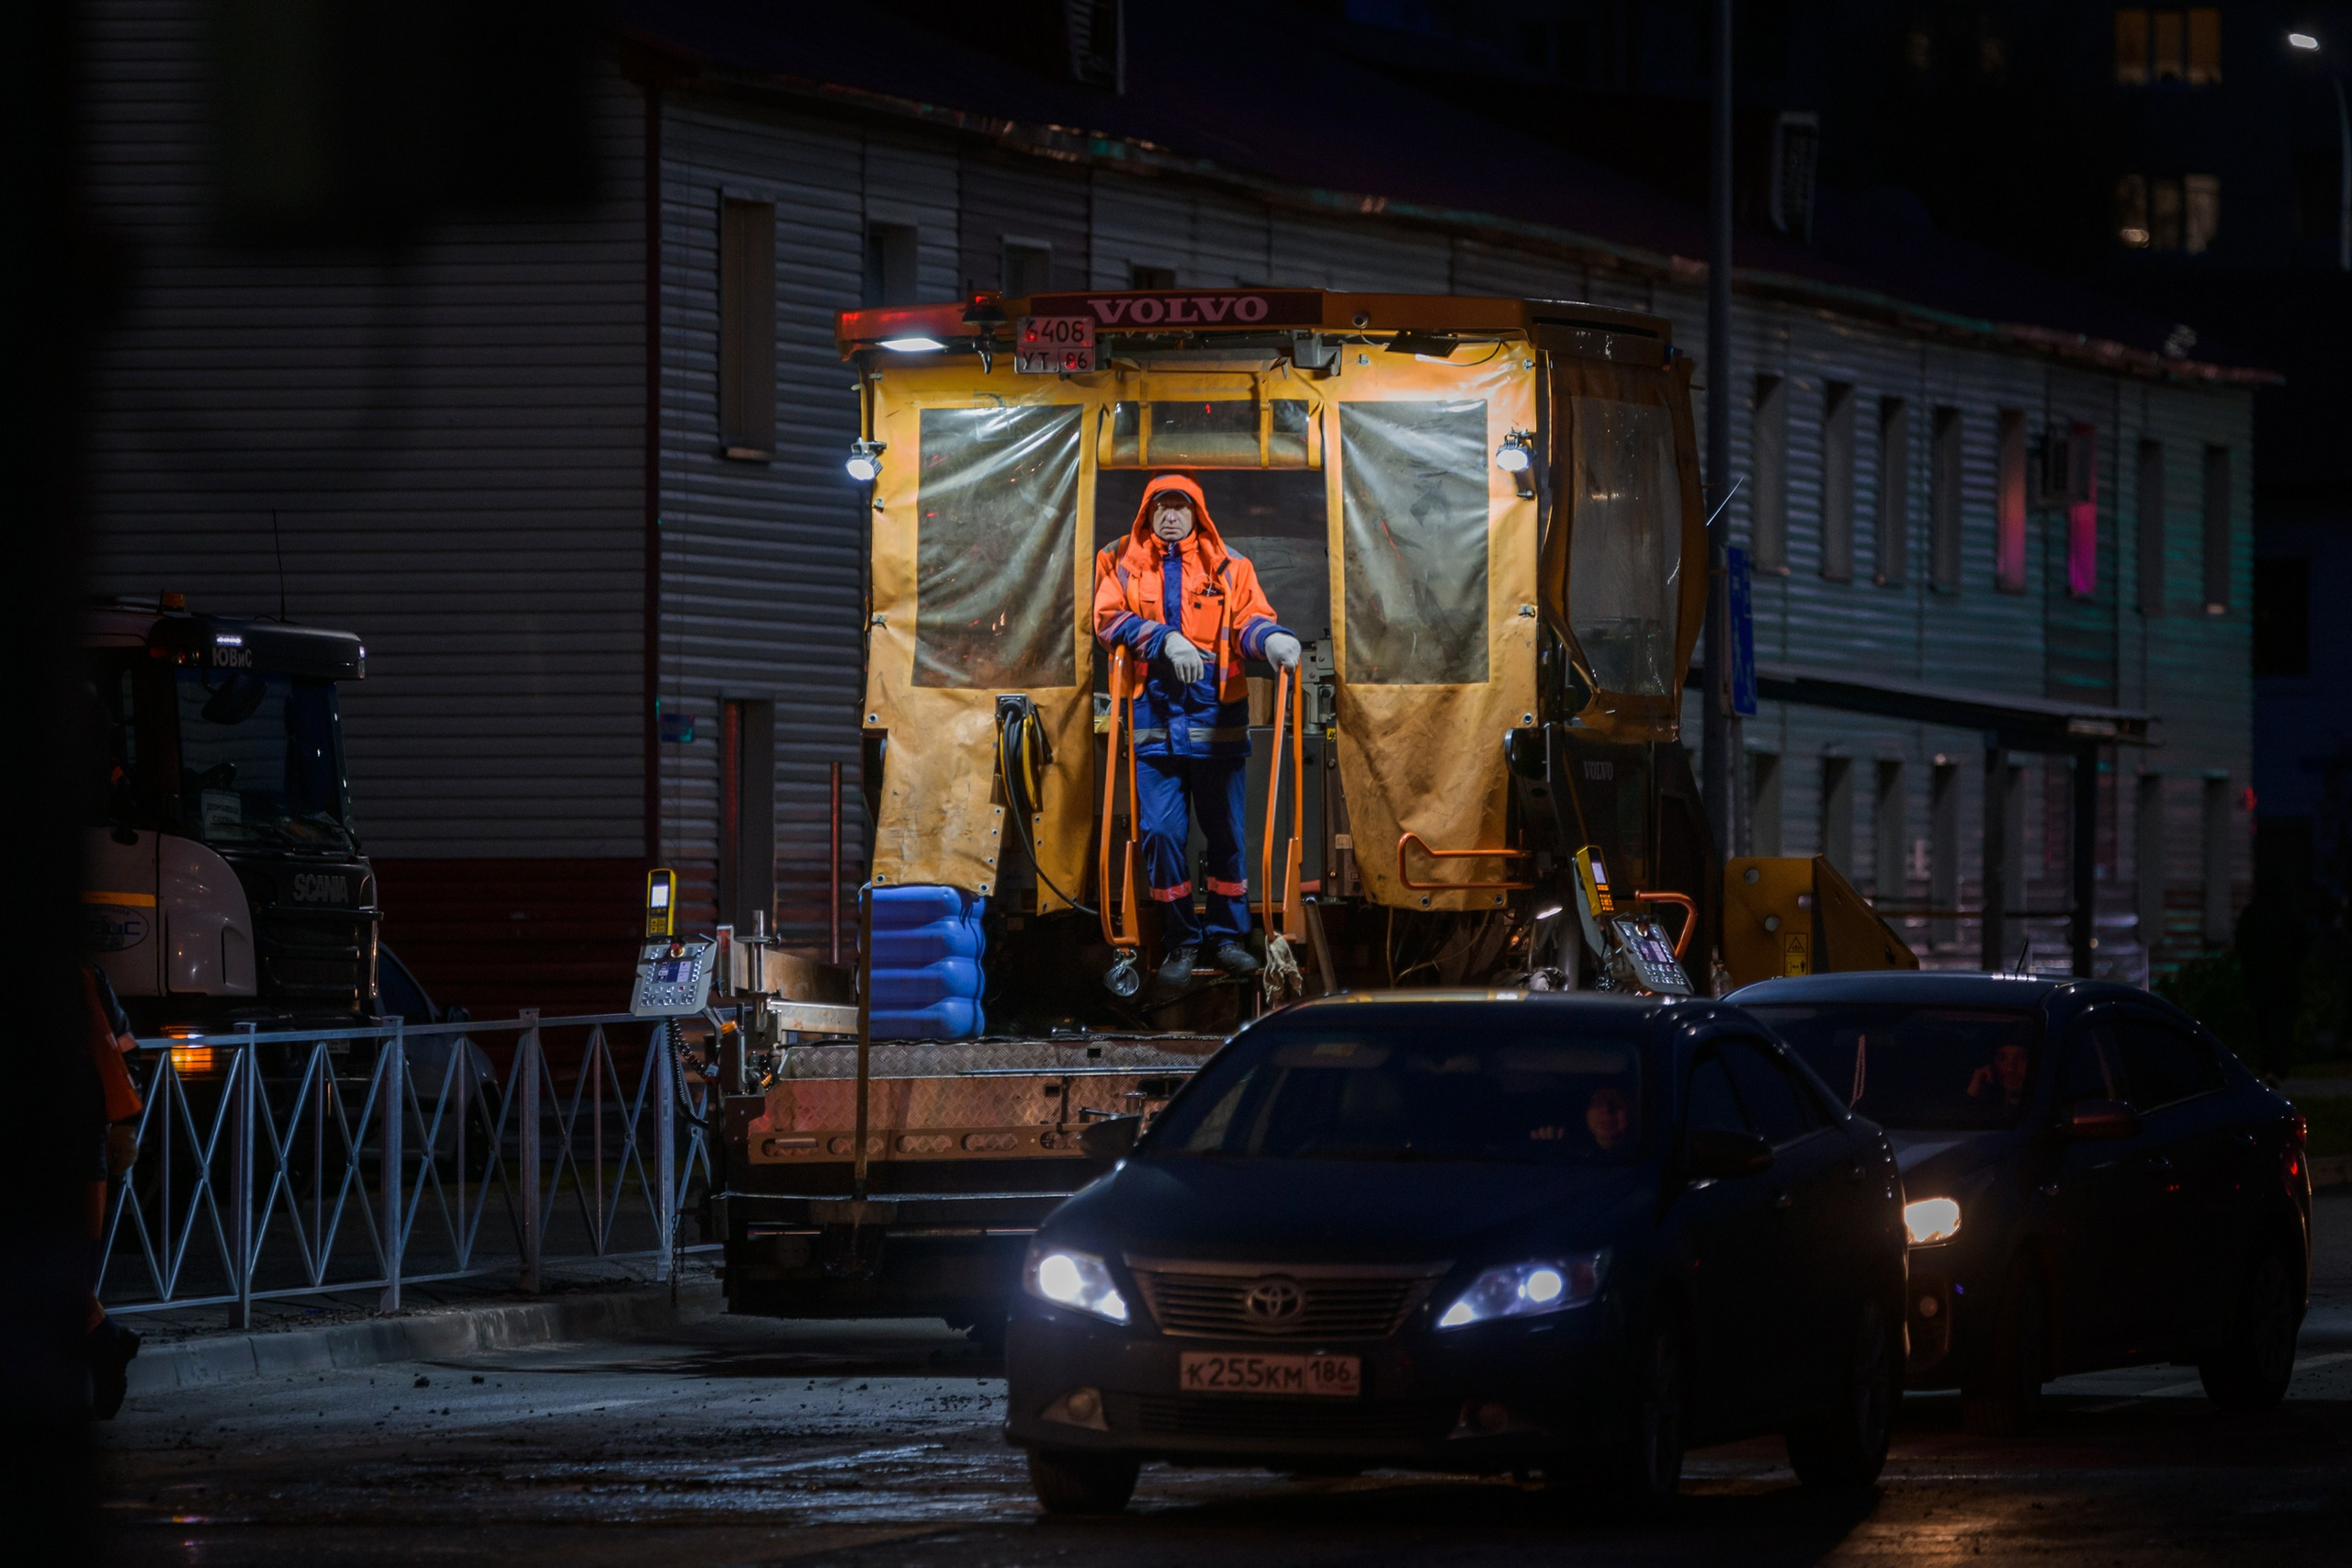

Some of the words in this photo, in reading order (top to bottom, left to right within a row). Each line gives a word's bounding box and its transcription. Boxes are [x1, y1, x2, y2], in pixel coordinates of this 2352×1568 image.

[1088, 296, 1269, 323] VOLVO
[1024, 320, 1084, 343] 6408
[1066, 352, 1087, 369] 86
[1583, 760, 1613, 781] VOLVO
[292, 874, 349, 903] SCANIA
[1186, 1358, 1303, 1389] К255КМ
[1309, 1359, 1351, 1383] 186
